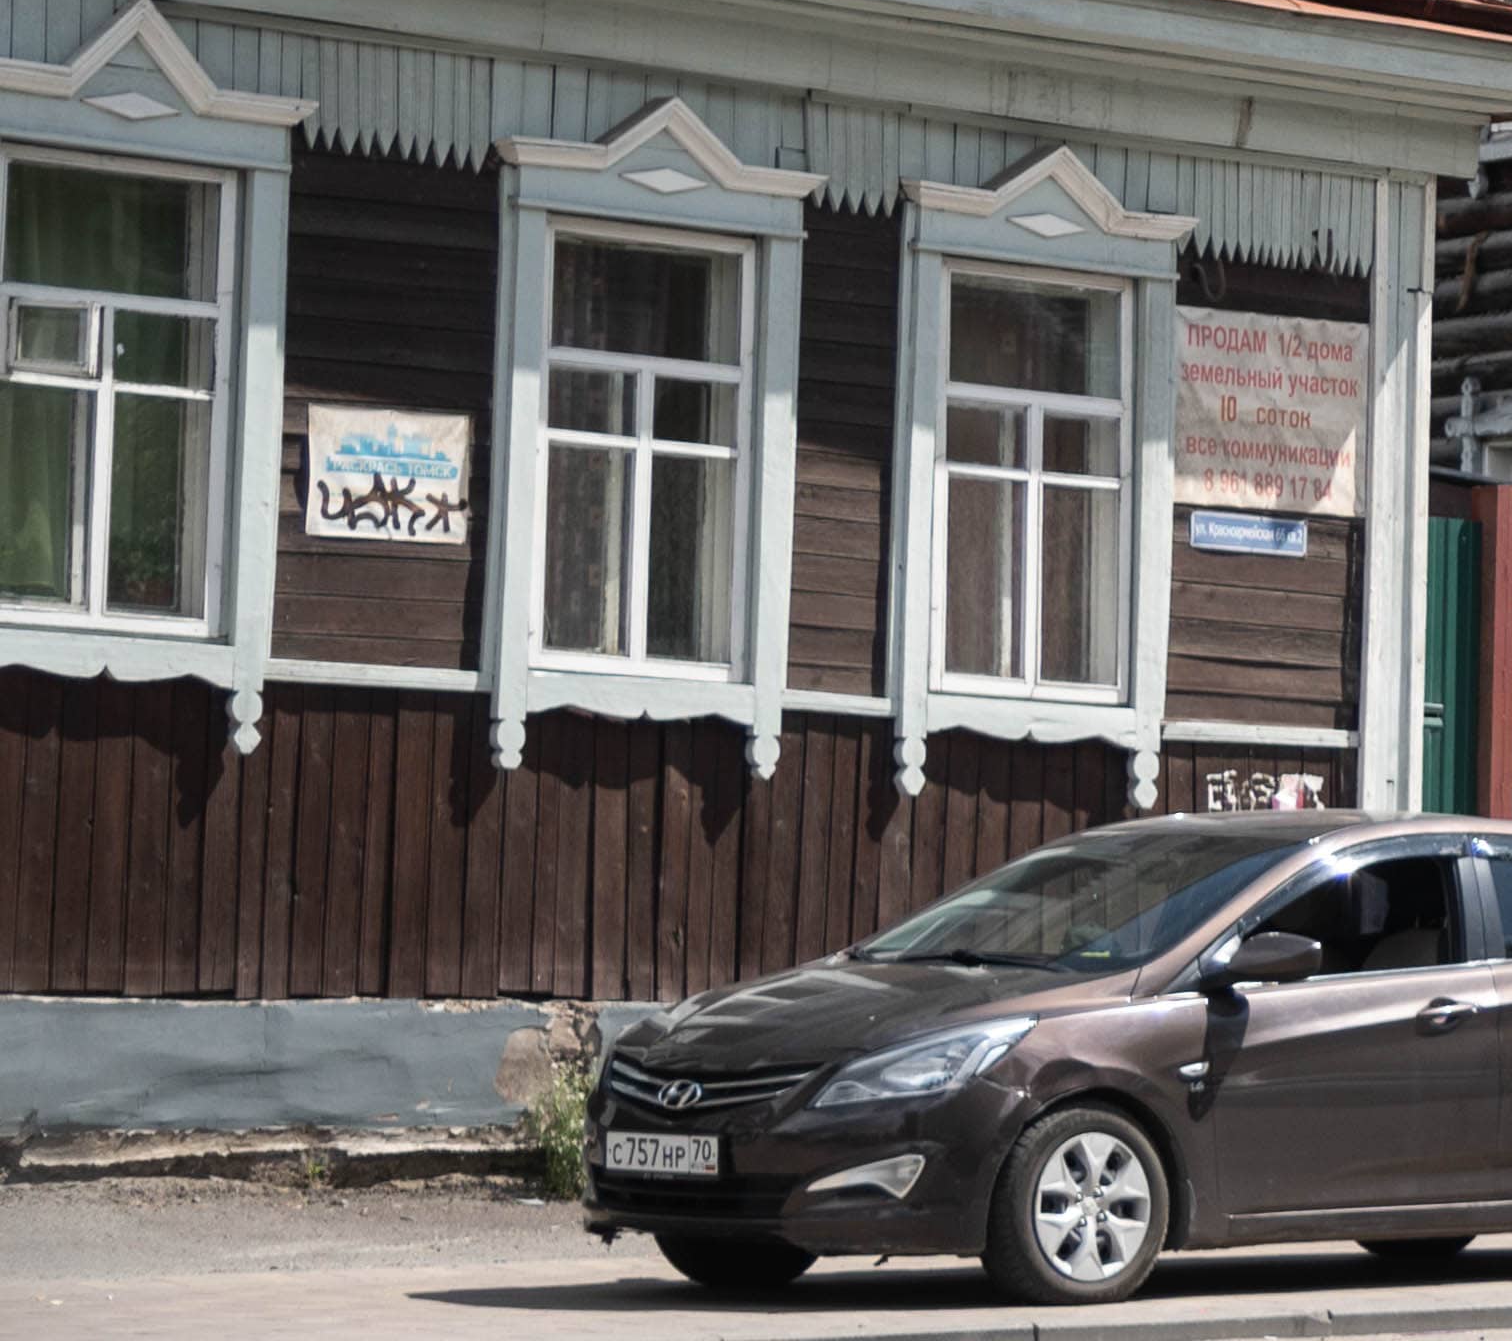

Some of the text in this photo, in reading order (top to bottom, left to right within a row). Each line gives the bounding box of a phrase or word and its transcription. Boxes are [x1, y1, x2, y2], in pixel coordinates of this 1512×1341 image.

[1187, 323, 1353, 363] ПРОДАМ 1/2 дома
[1181, 362, 1358, 398] земельный участок
[1220, 394, 1312, 429] 10 соток
[1186, 436, 1351, 469] все коммуникации
[1203, 468, 1332, 502] 8 961 889 17 84
[692, 1138, 712, 1162] 70
